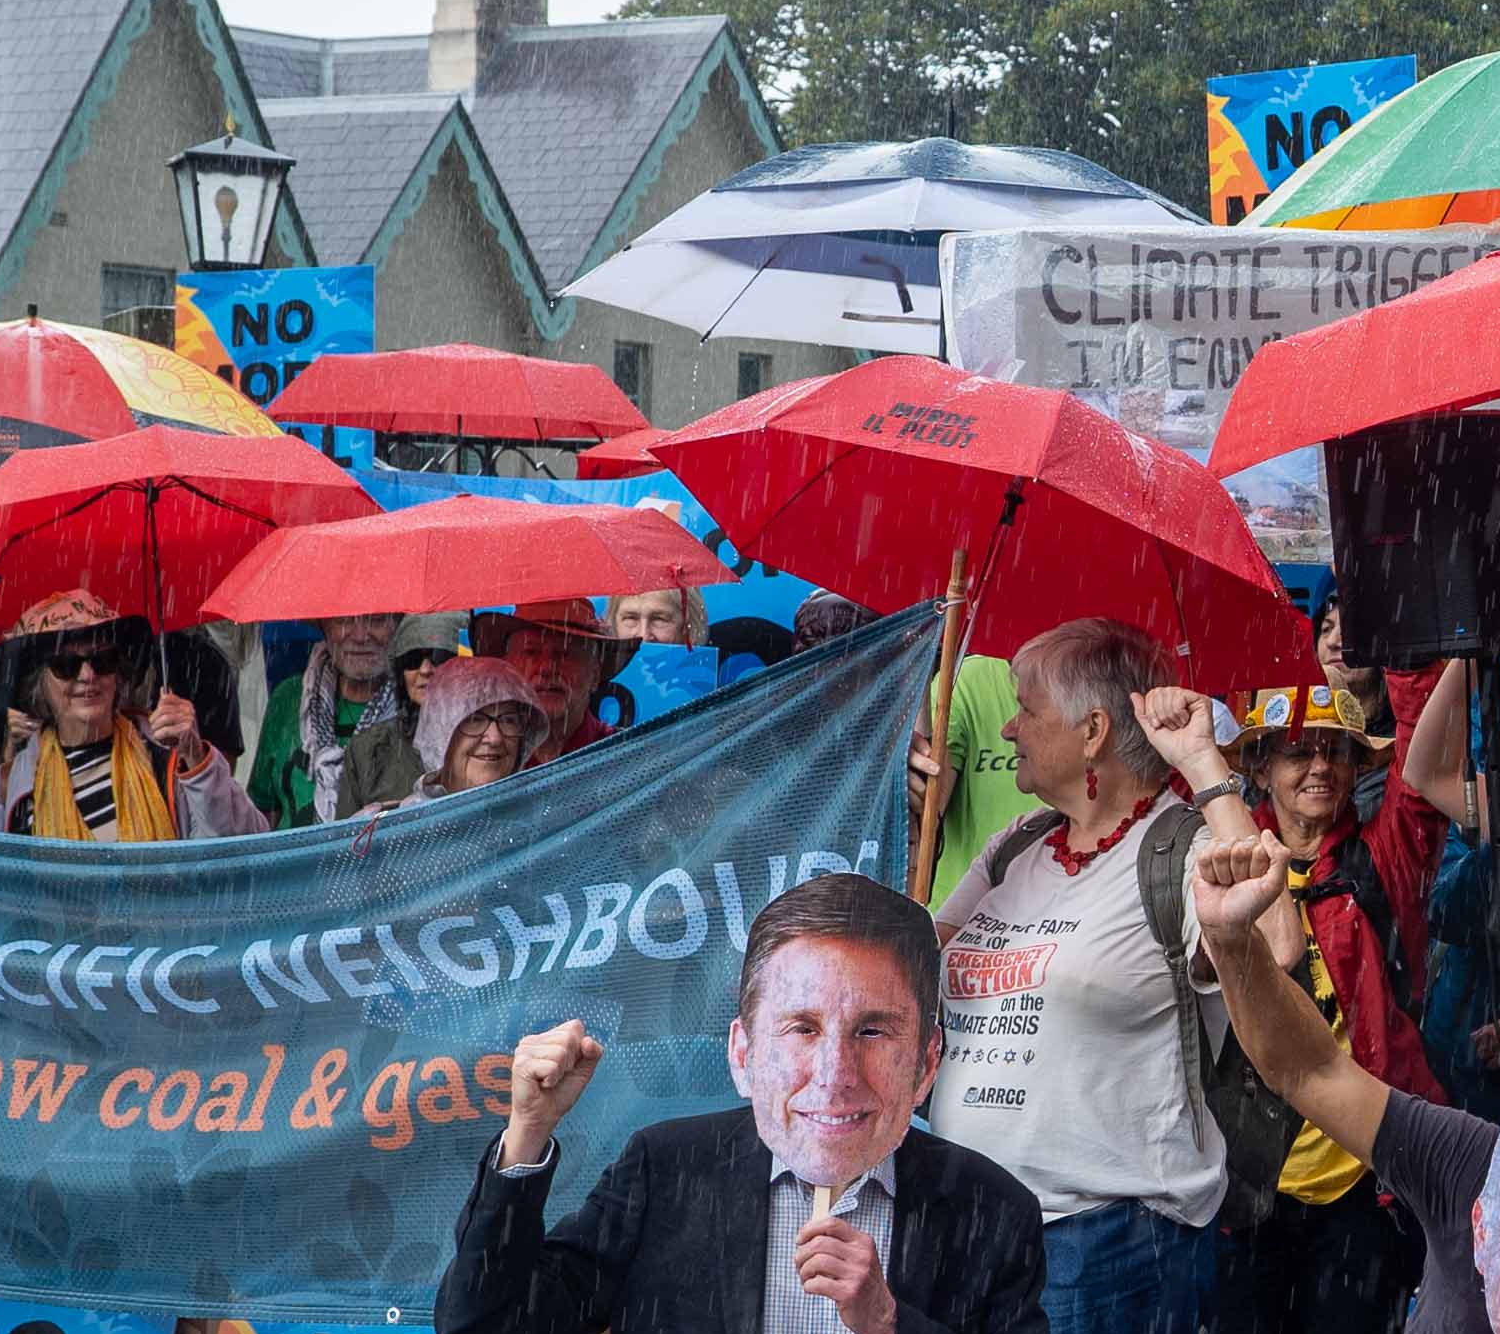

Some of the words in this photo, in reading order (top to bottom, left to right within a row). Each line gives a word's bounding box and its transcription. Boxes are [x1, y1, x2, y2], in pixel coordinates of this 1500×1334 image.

[1265, 104, 1351, 172] NO
[1040, 244, 1283, 327] CLIMATE
[232, 300, 314, 347] NO
[1067, 340, 1144, 390] IN
[947, 947, 1046, 968] EMERGENCY
[948, 962, 1035, 996] ACTION
[1000, 997, 1016, 1012] on
[1020, 993, 1045, 1012] the
[989, 1015, 1040, 1035] CRISIS
[100, 1043, 286, 1134] coal
[289, 1047, 350, 1130] &
[361, 1051, 514, 1150] gas
[977, 1086, 1027, 1106] ARRCC
